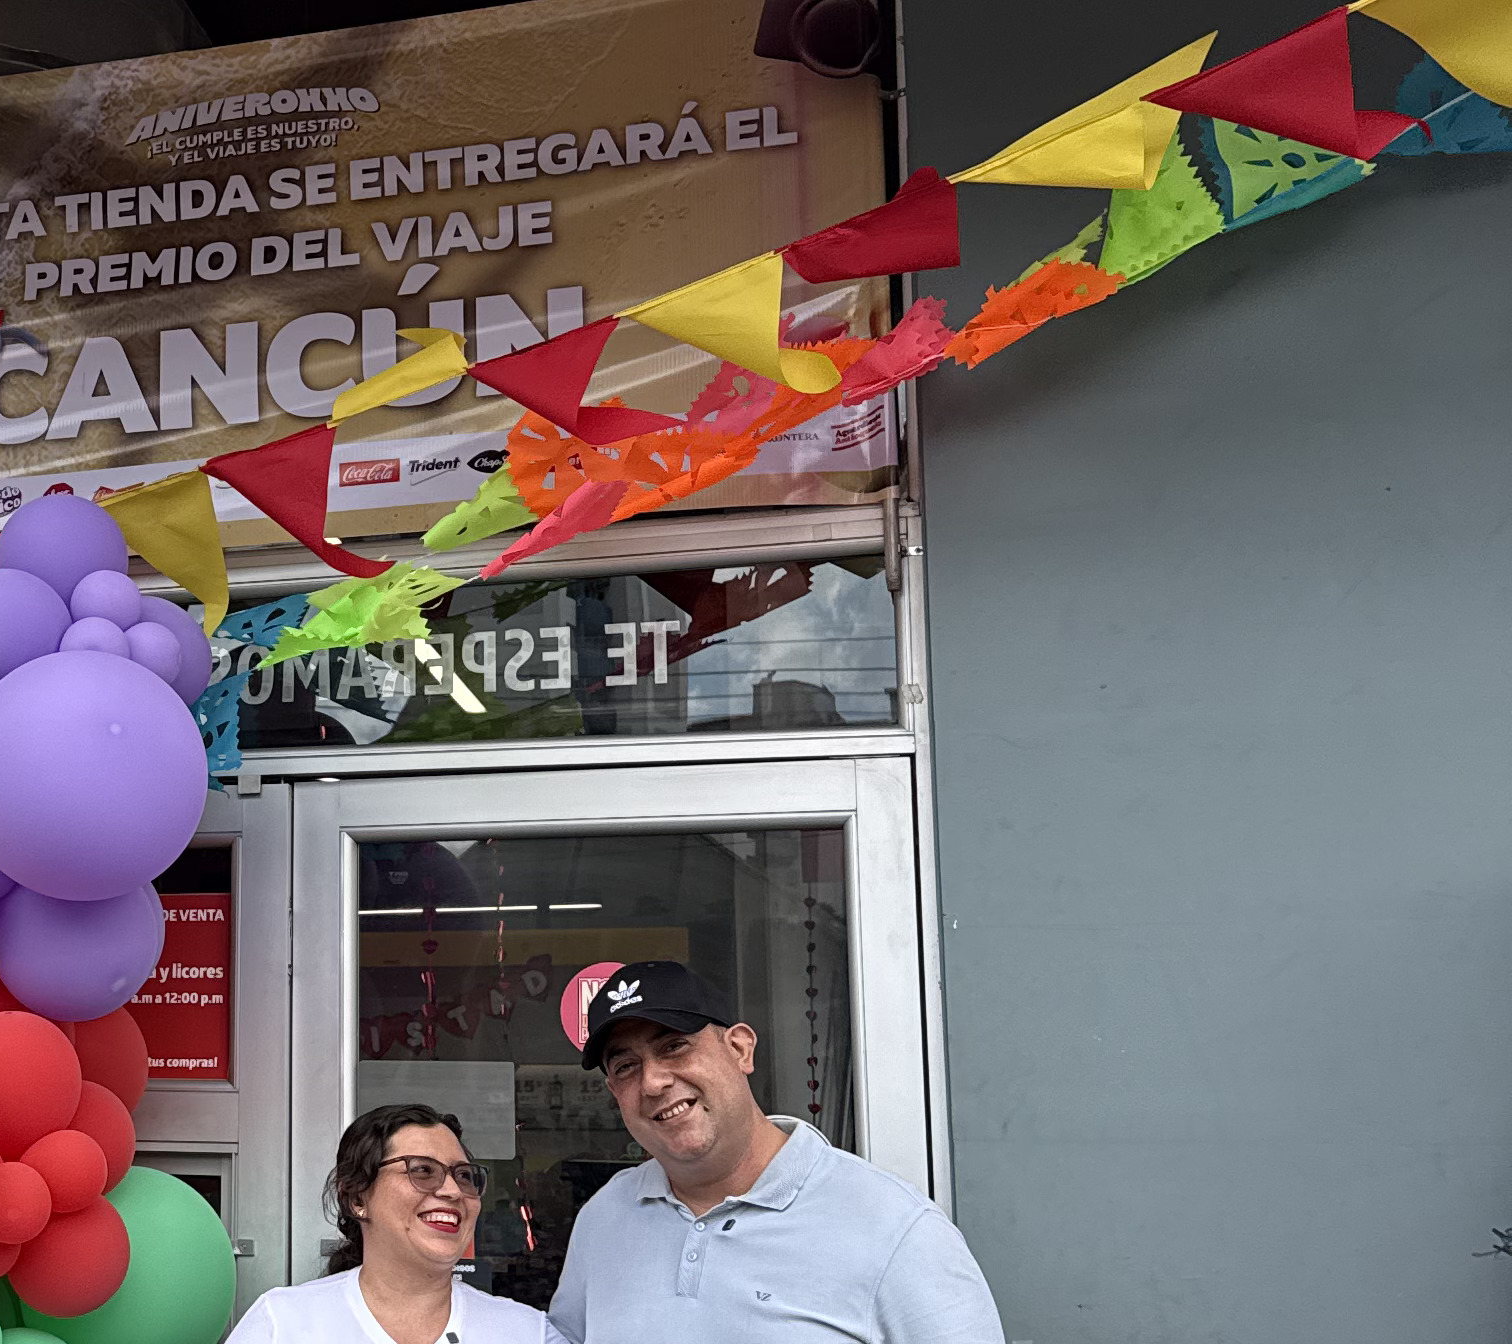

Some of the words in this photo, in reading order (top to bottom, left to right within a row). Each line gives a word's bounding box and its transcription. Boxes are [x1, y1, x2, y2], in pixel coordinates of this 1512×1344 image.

[174, 127, 245, 151] CUMPLE
[246, 124, 269, 139] ES
[270, 117, 360, 137] NUESTRO,
[168, 153, 182, 167] Y
[183, 150, 204, 165] EL
[205, 143, 257, 160] VIAJE
[260, 139, 282, 153] ES
[283, 133, 338, 150] TUYO!
[54, 173, 257, 232] TIENDA
[268, 162, 338, 211] SE
[348, 100, 714, 202] ENTREGARÁ
[724, 105, 799, 153] EL
[22, 239, 238, 302] PREMIO
[249, 227, 360, 277] DEL
[370, 199, 554, 263] VIAJE
[408, 456, 462, 474] Trident
[179, 908, 225, 922] VENTA
[159, 967, 170, 984] y
[172, 962, 224, 979] licores
[154, 995, 162, 1004] a
[164, 992, 199, 1004] 12:00
[200, 994, 224, 1007] p.m
[147, 1056, 165, 1068] tus
